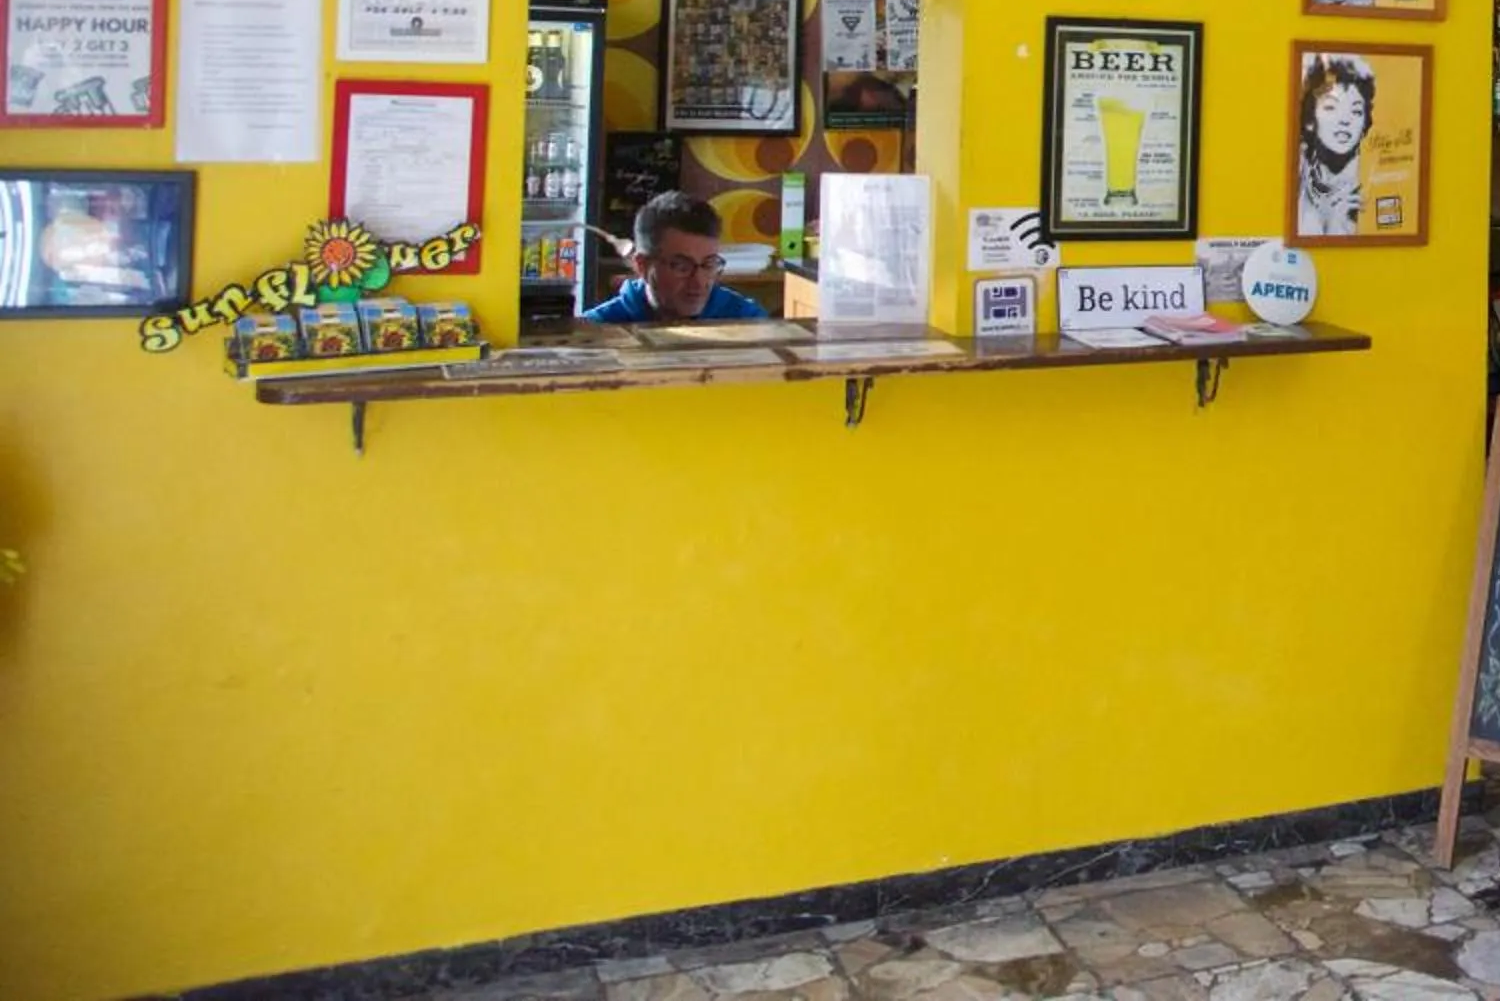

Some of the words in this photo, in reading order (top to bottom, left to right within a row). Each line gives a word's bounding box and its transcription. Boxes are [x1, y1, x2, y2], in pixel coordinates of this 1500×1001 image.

[16, 16, 86, 32] HAPPY
[91, 18, 149, 34] HOUR
[1072, 51, 1174, 72] BEER
[1078, 285, 1113, 312] Be
[1122, 283, 1187, 311] kind
[1251, 281, 1309, 302] APERTI
